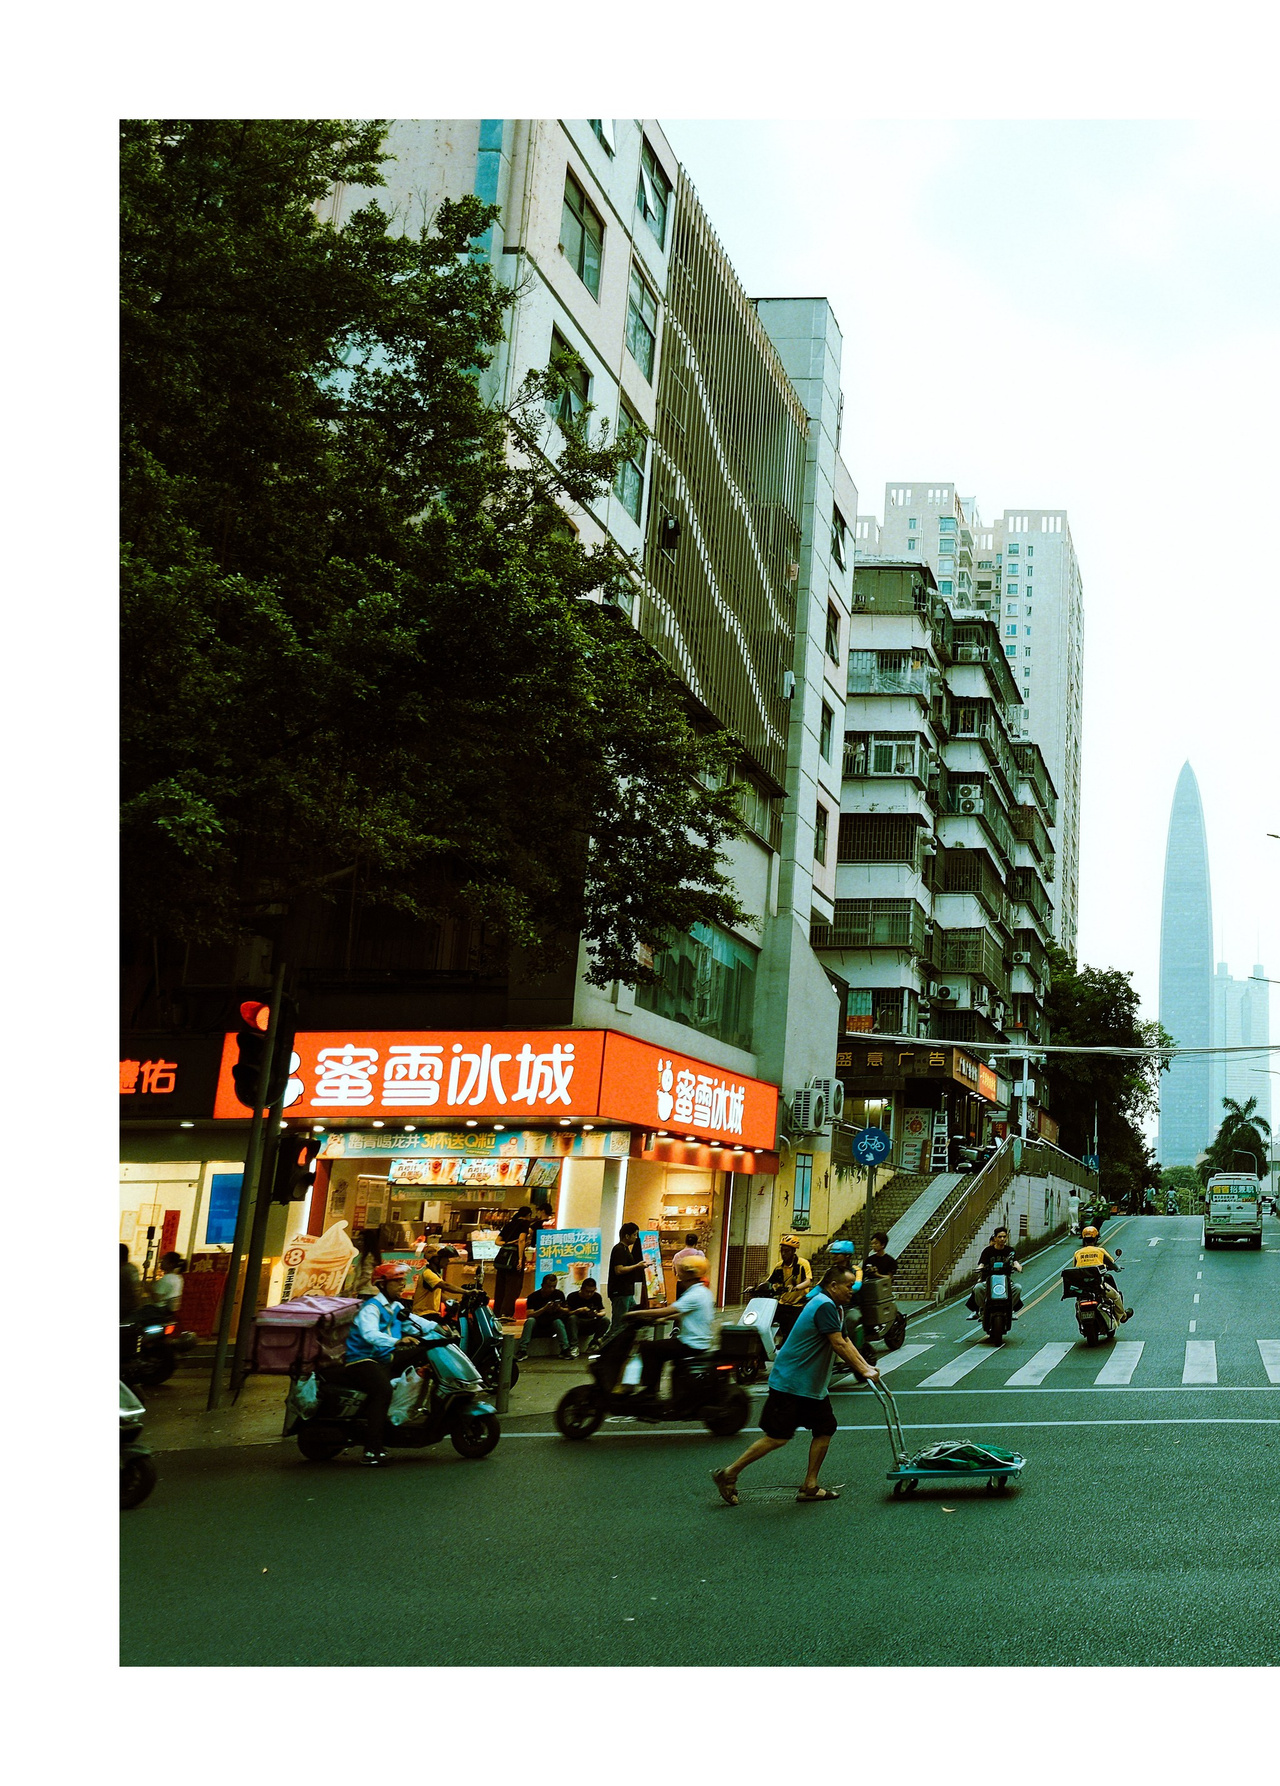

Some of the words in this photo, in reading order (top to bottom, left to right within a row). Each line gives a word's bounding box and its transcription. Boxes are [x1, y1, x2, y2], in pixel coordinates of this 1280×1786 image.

[836, 1051, 945, 1068] 盛意广告
[310, 1043, 575, 1107] 蜜雪冰城
[673, 1068, 745, 1135] 蜜雪冰城
[347, 1133, 420, 1149] 踏青喝龙井
[421, 1132, 496, 1150] 3杯送Q粒
[540, 1231, 598, 1246] 踏青喝龙井
